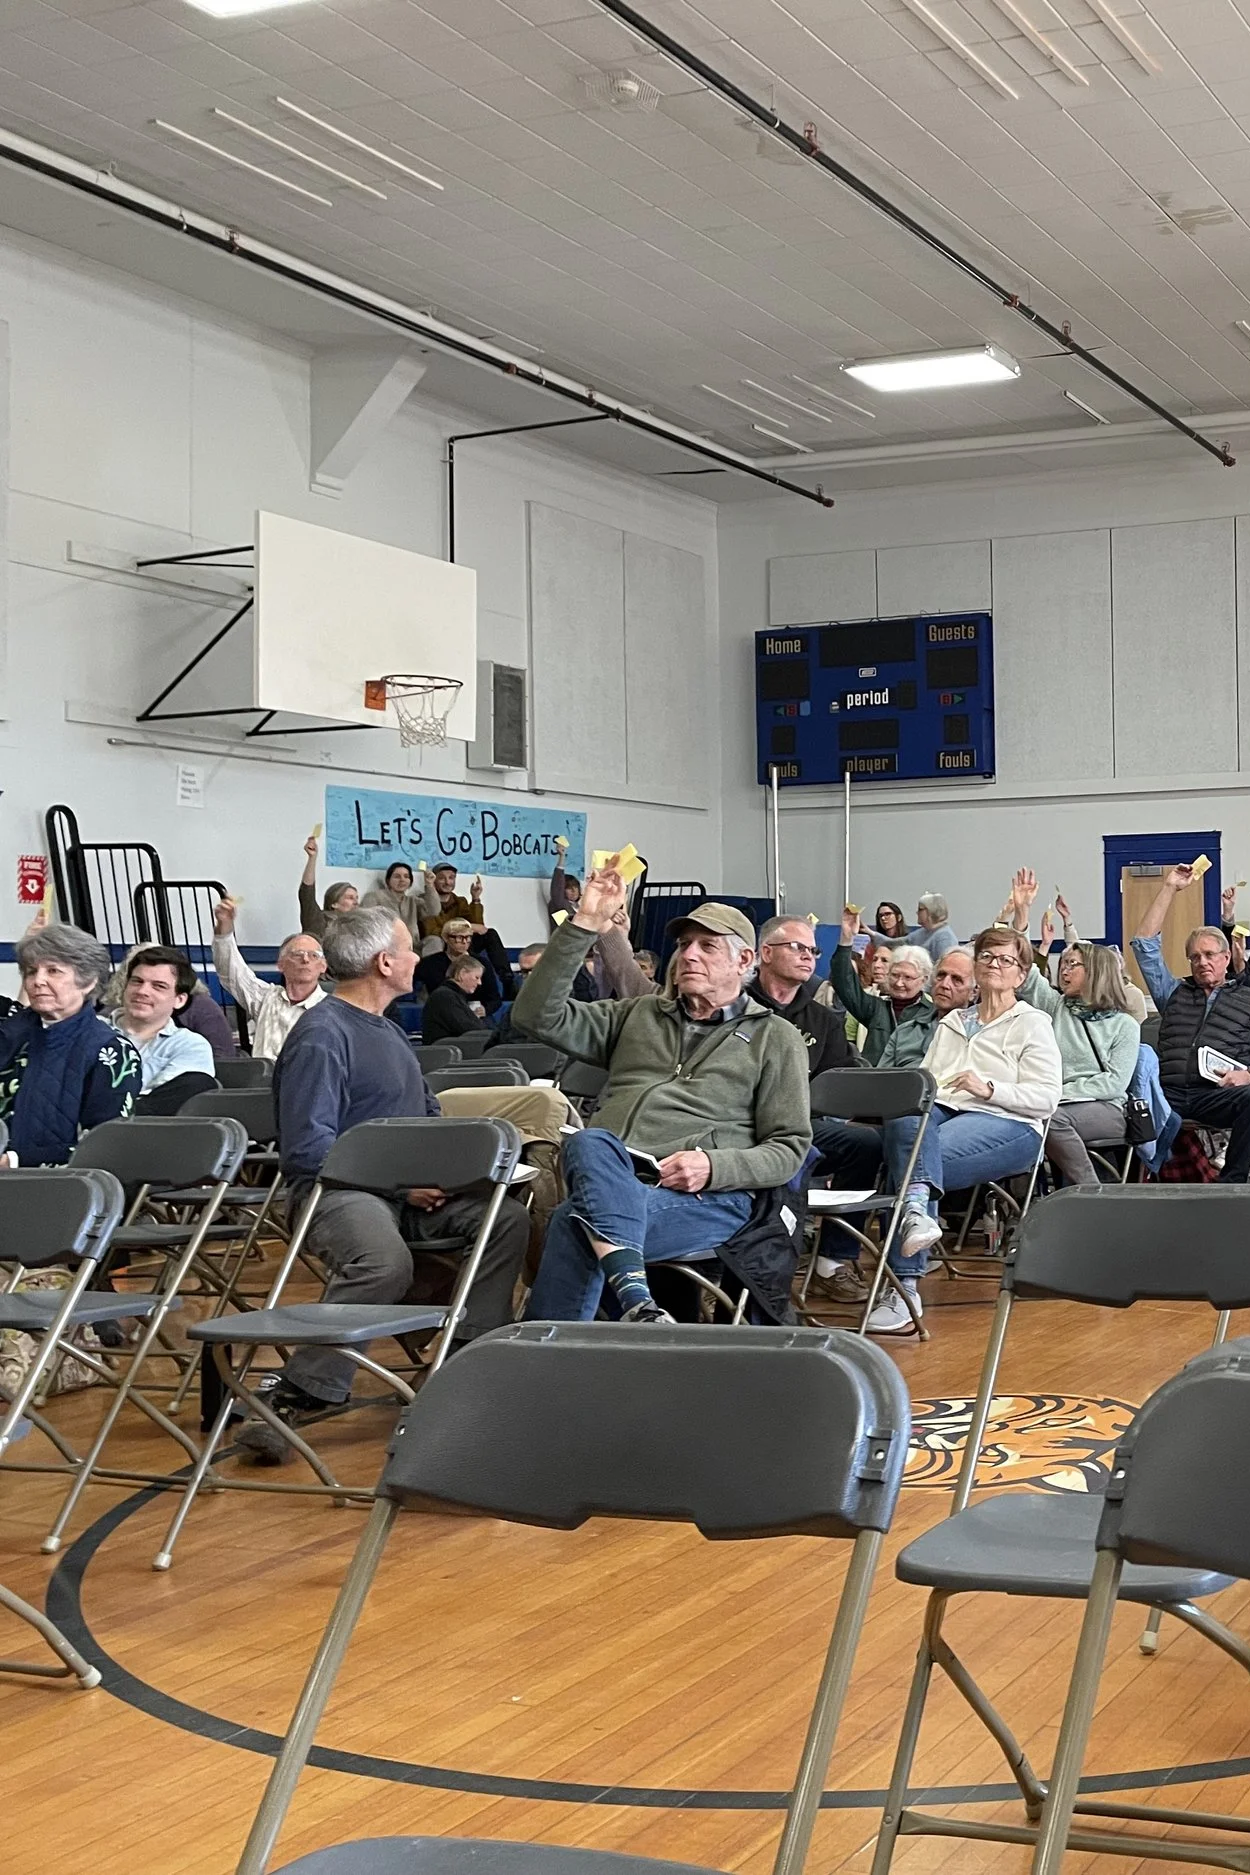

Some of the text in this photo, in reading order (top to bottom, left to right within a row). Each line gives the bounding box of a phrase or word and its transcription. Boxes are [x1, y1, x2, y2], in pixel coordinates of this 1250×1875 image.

[928, 624, 976, 642] Guests
[766, 638, 801, 655] Home
[846, 687, 889, 710] period
[939, 751, 971, 768] fouls
